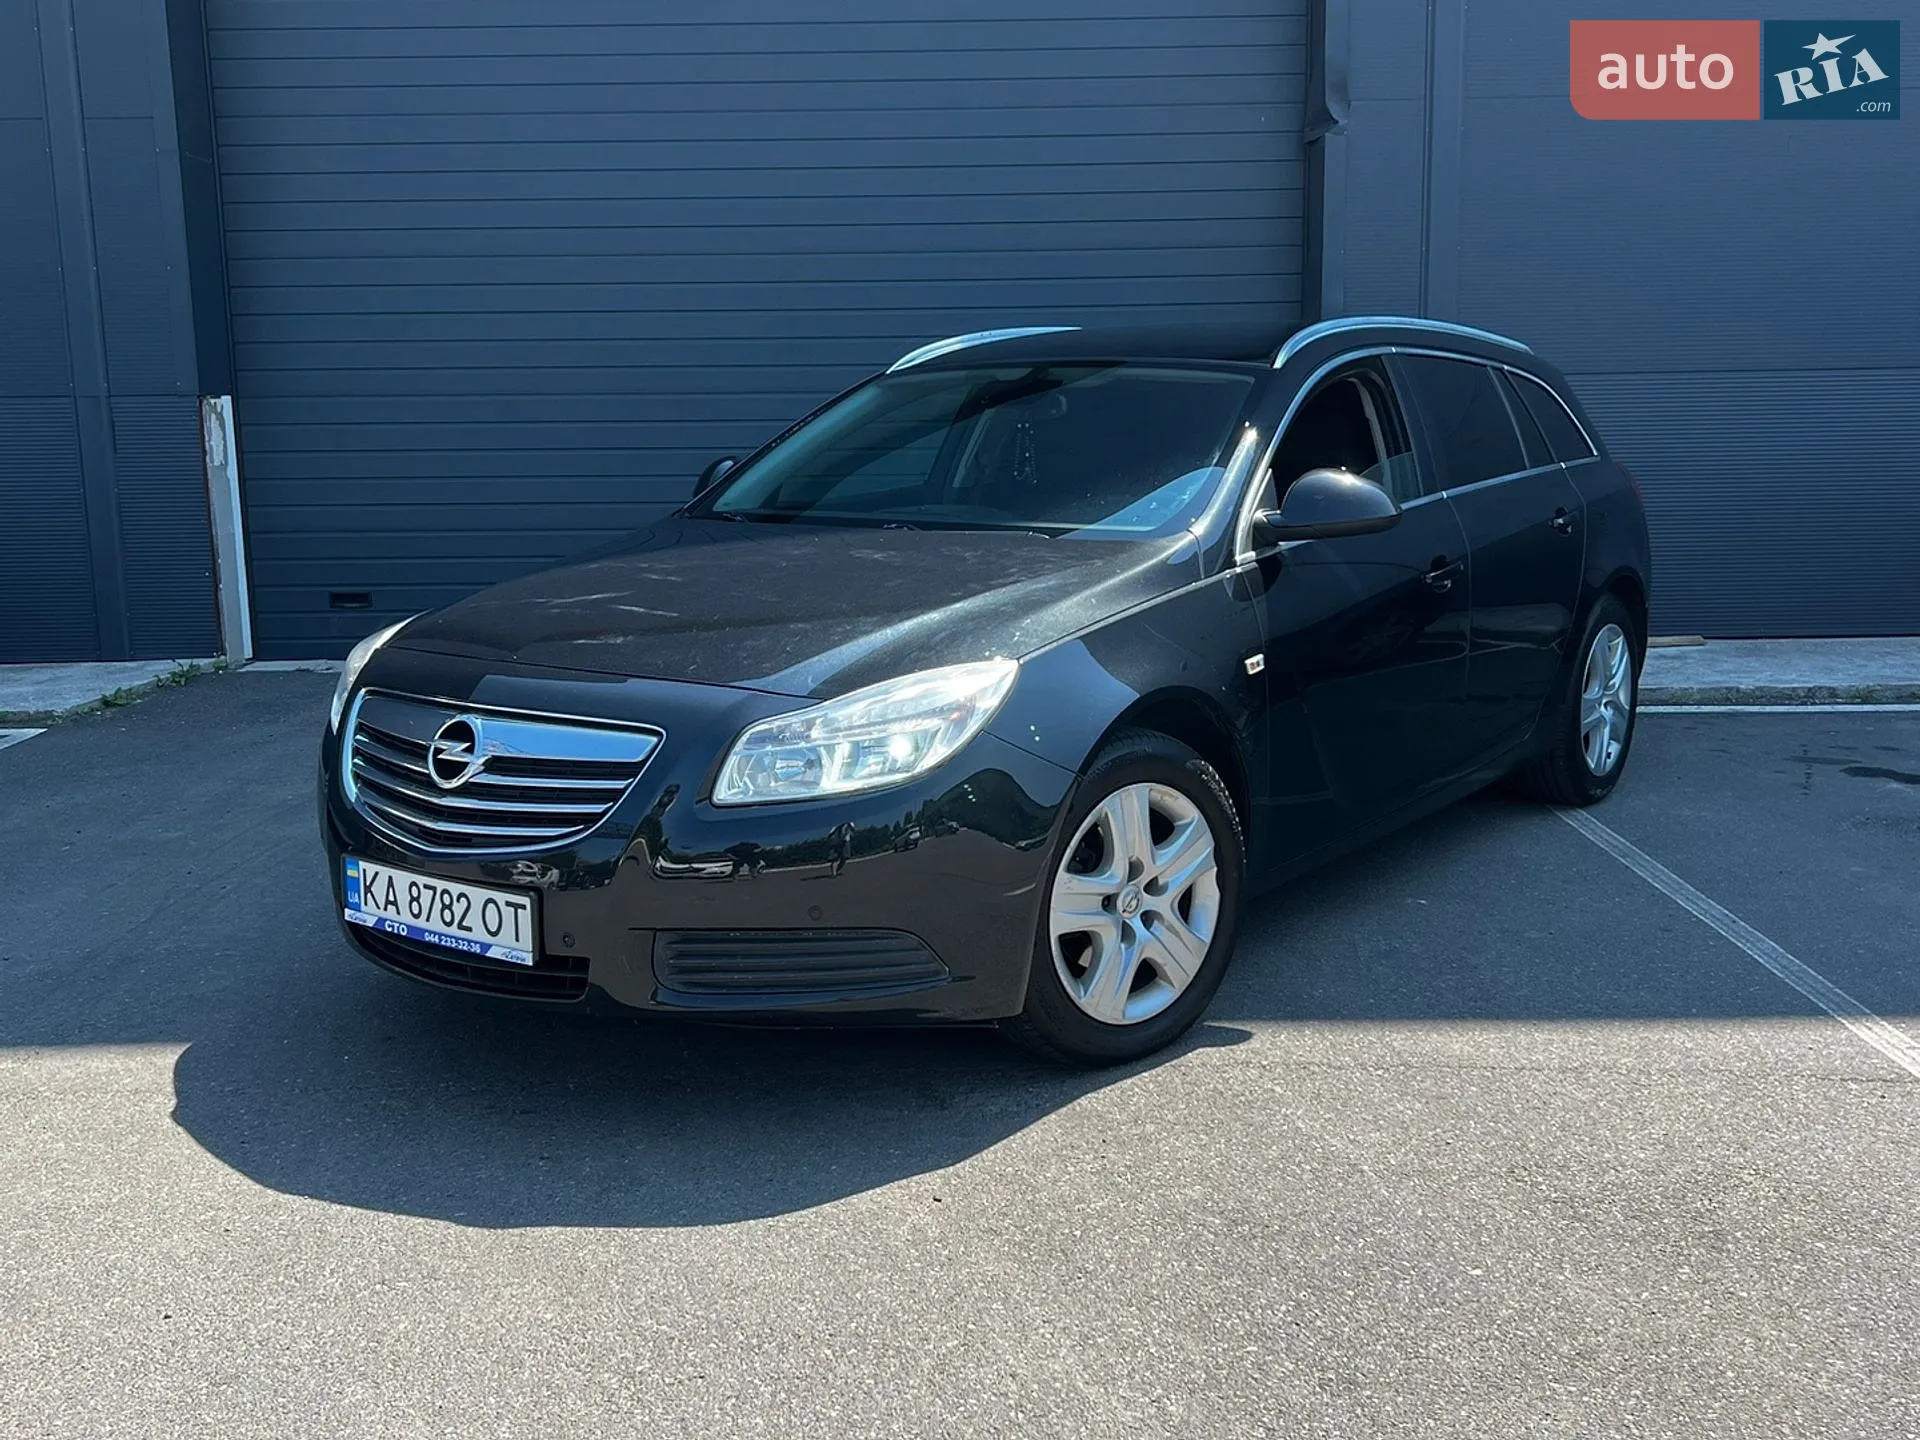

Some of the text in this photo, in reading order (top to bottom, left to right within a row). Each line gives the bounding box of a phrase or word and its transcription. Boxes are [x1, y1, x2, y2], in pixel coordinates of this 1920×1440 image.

[347, 890, 359, 904] UA
[362, 868, 527, 943] KA 8782 OT
